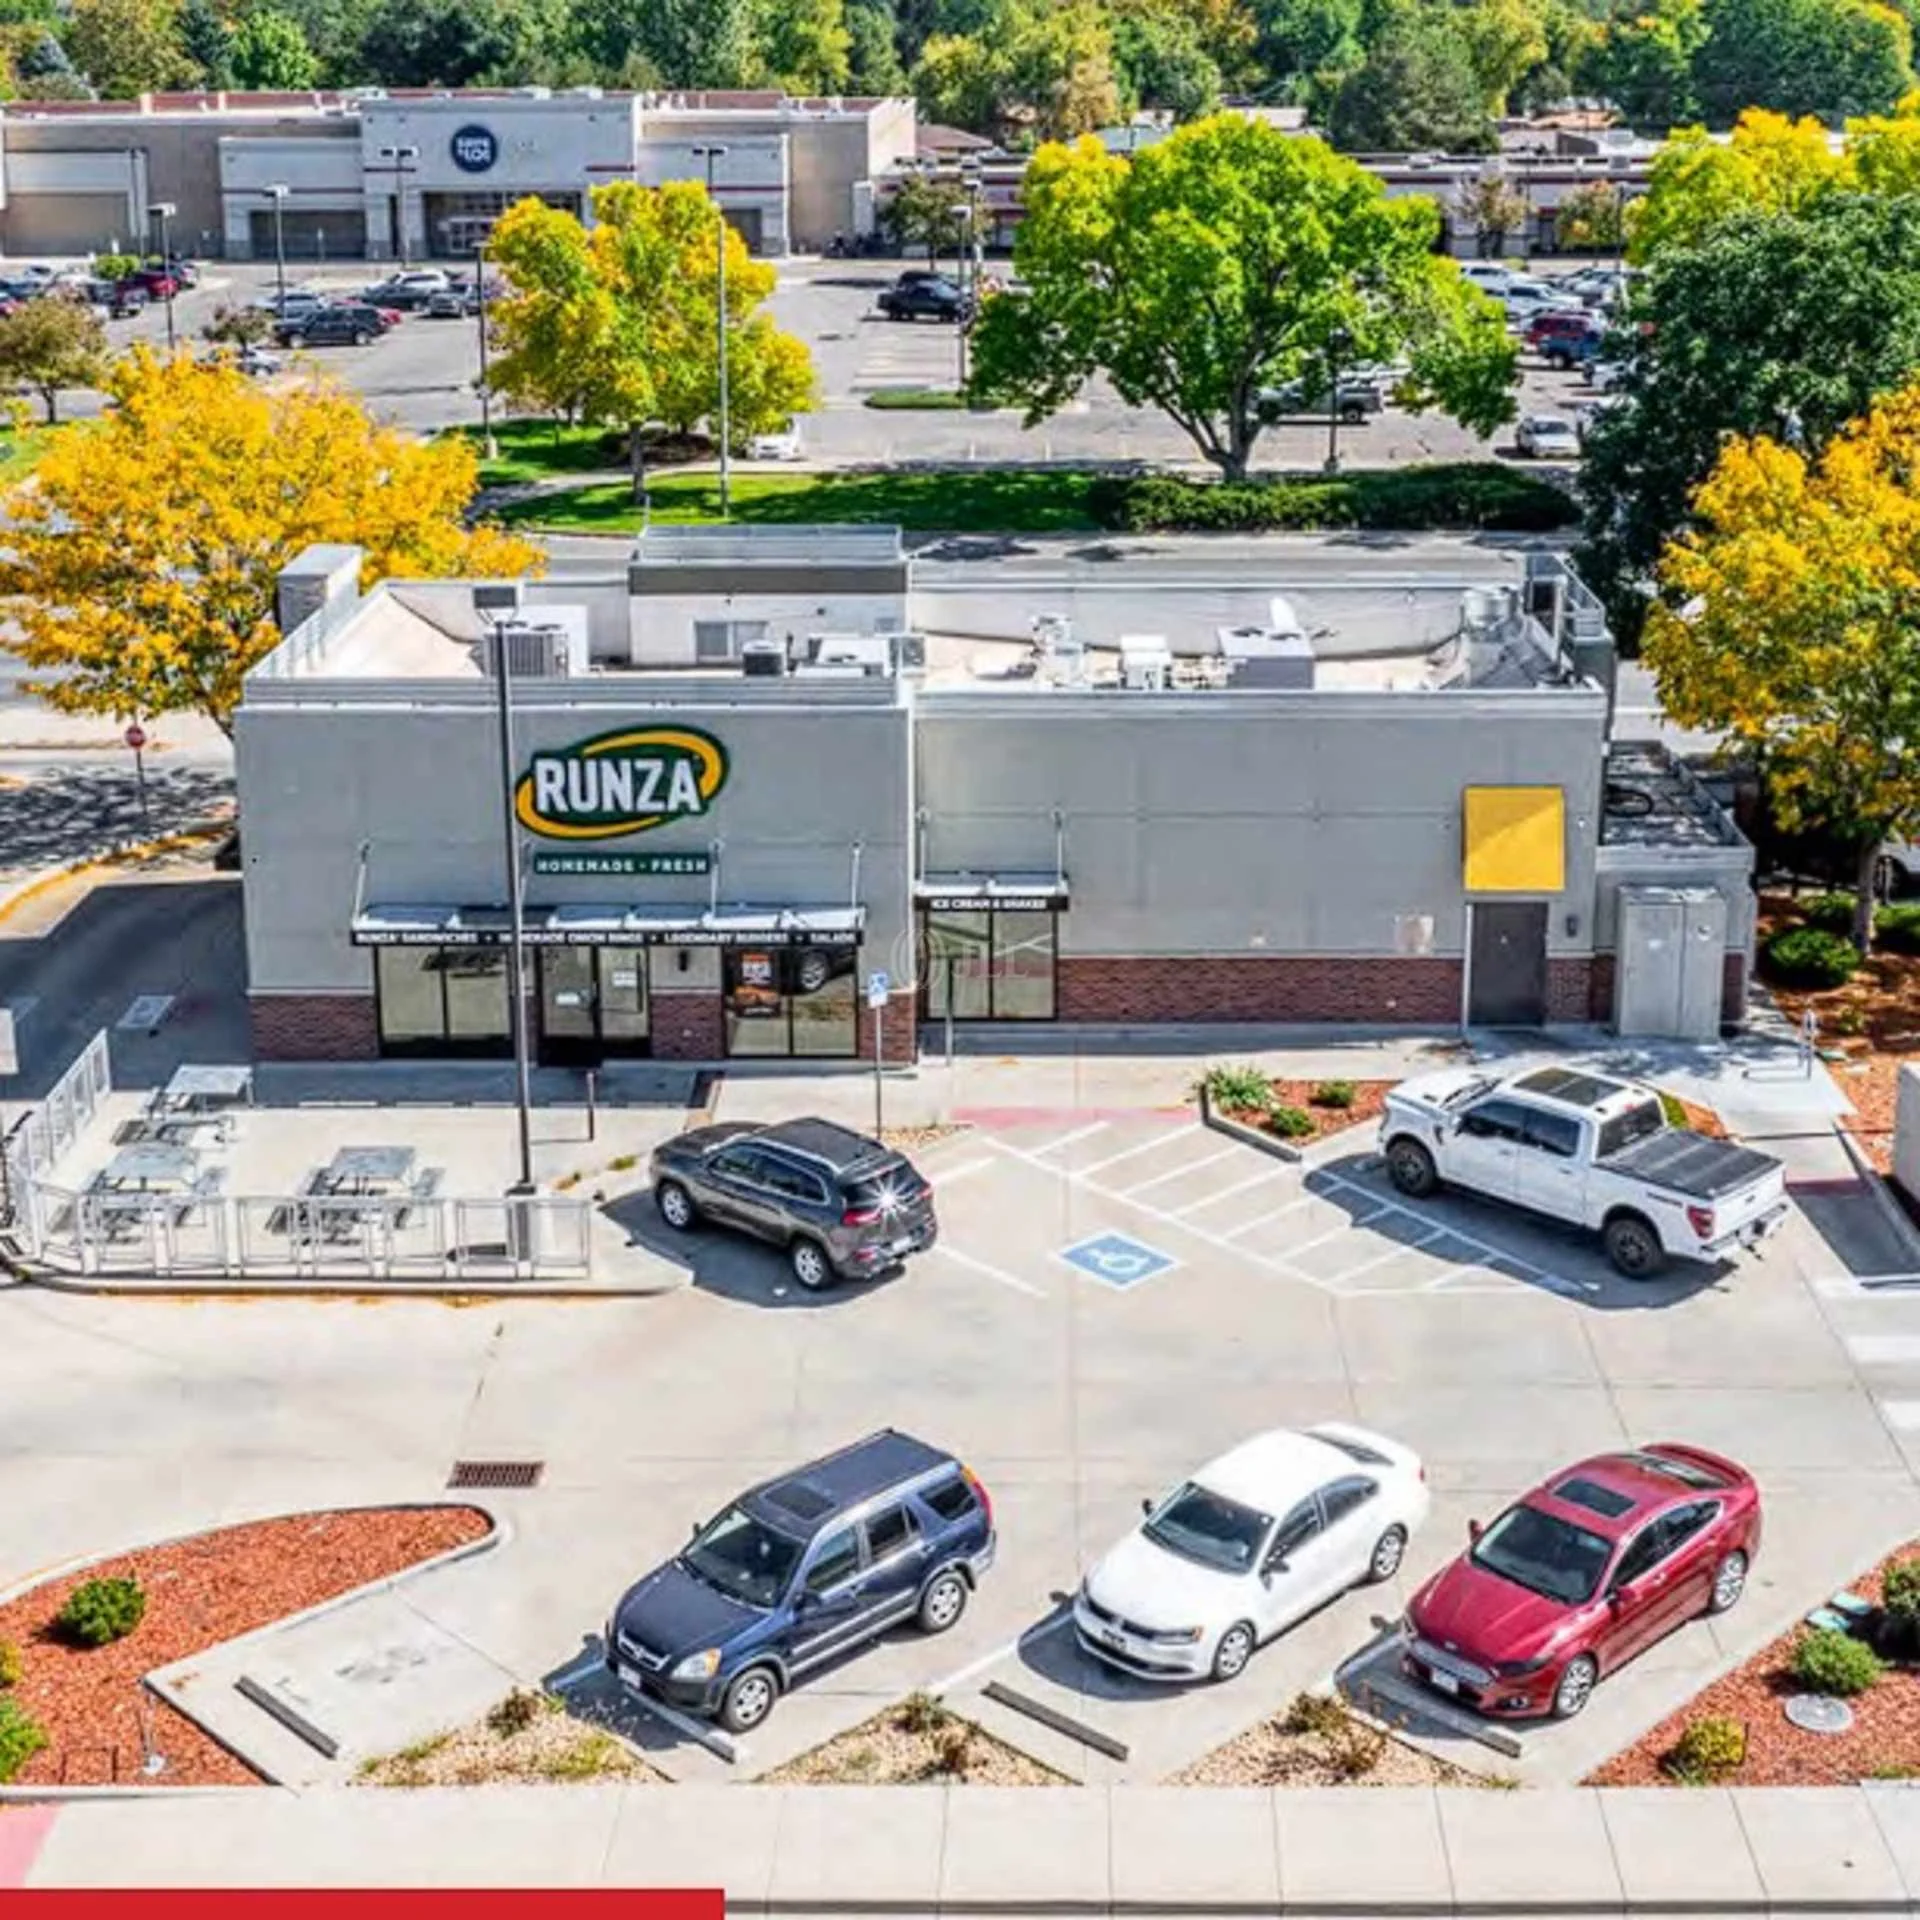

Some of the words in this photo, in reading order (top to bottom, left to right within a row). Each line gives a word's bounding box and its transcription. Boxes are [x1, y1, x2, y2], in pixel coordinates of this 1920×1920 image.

[535, 758, 701, 813] RUNZA
[536, 857, 636, 873] HOMEMADE
[651, 857, 707, 873] FRESH
[951, 898, 991, 910] CREAM
[498, 932, 565, 944] HOEMADE
